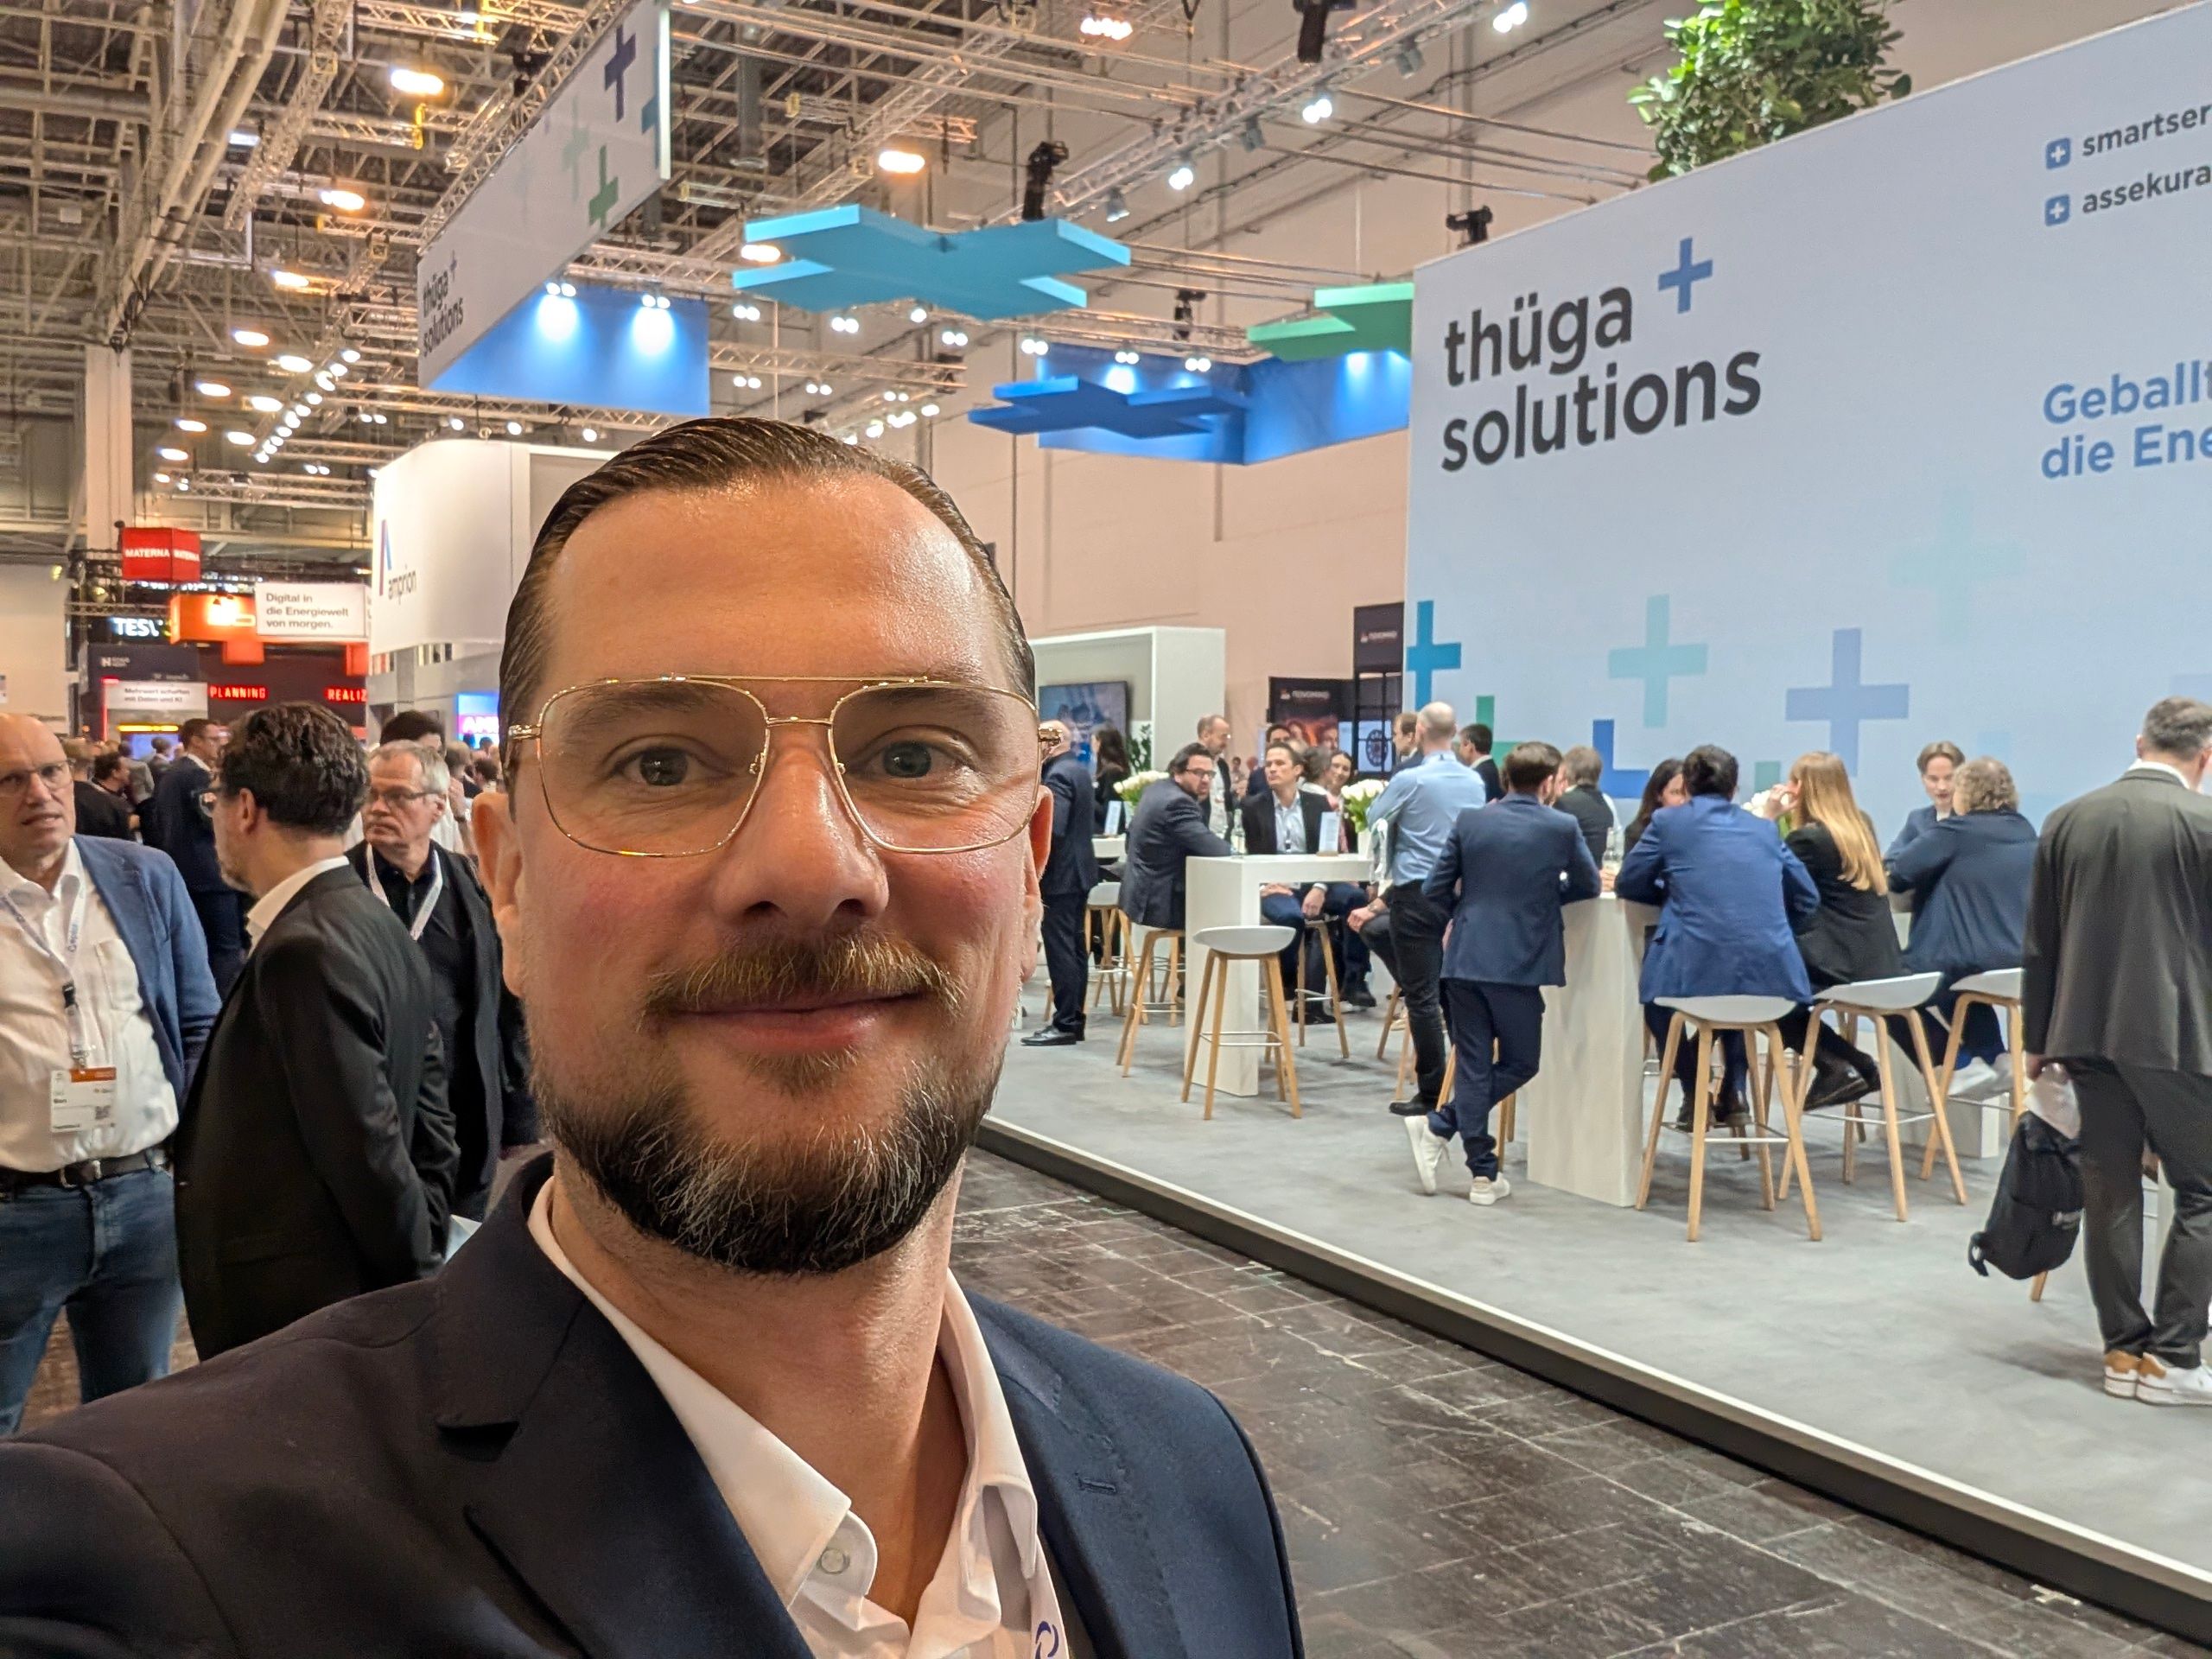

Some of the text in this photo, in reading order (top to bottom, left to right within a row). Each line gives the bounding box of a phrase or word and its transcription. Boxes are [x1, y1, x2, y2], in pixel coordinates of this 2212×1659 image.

[2082, 165, 2212, 213] assekura
[1445, 287, 1632, 387] thüga
[1441, 351, 1761, 472] solutions
[2041, 435, 2114, 480] die
[124, 548, 170, 558] MATERNA
[266, 593, 313, 604] Digital in
[266, 607, 349, 618] die Energiewelt
[210, 686, 266, 699] PLANNING
